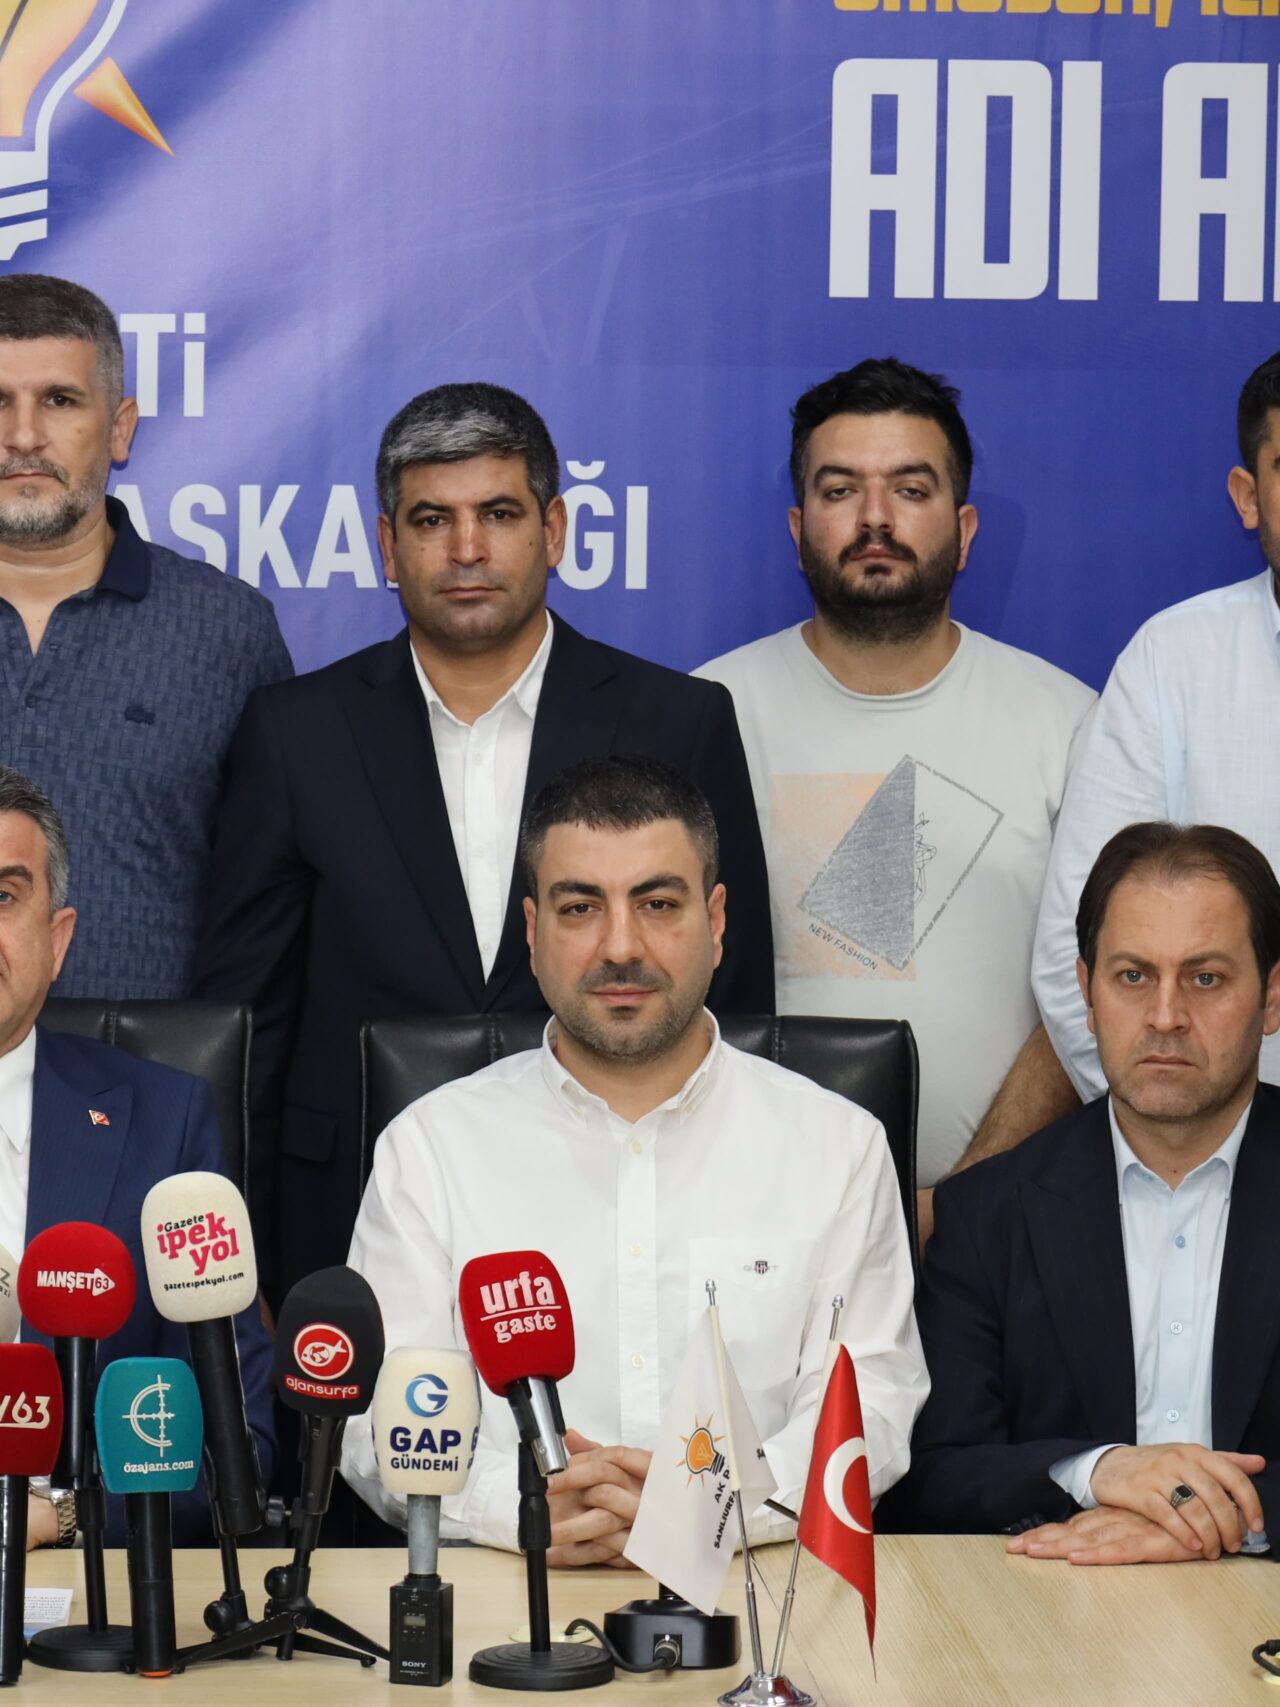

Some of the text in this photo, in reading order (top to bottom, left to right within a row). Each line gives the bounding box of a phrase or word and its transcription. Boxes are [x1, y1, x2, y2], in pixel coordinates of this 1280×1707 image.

[828, 57, 1280, 302] ADI A
[808, 922, 879, 971] NEW FASHION
[156, 1211, 229, 1260] ipek
[164, 1214, 205, 1233] Gazete
[189, 1227, 240, 1277] yol
[479, 1270, 556, 1315] urfa
[493, 1310, 557, 1344] gaste
[285, 1377, 358, 1399] ajansurfa
[389, 1426, 462, 1455] GAP
[123, 1459, 195, 1475] özajans.com
[390, 1453, 459, 1472] GÜNDEMİ
[401, 1660, 427, 1668] SONY
